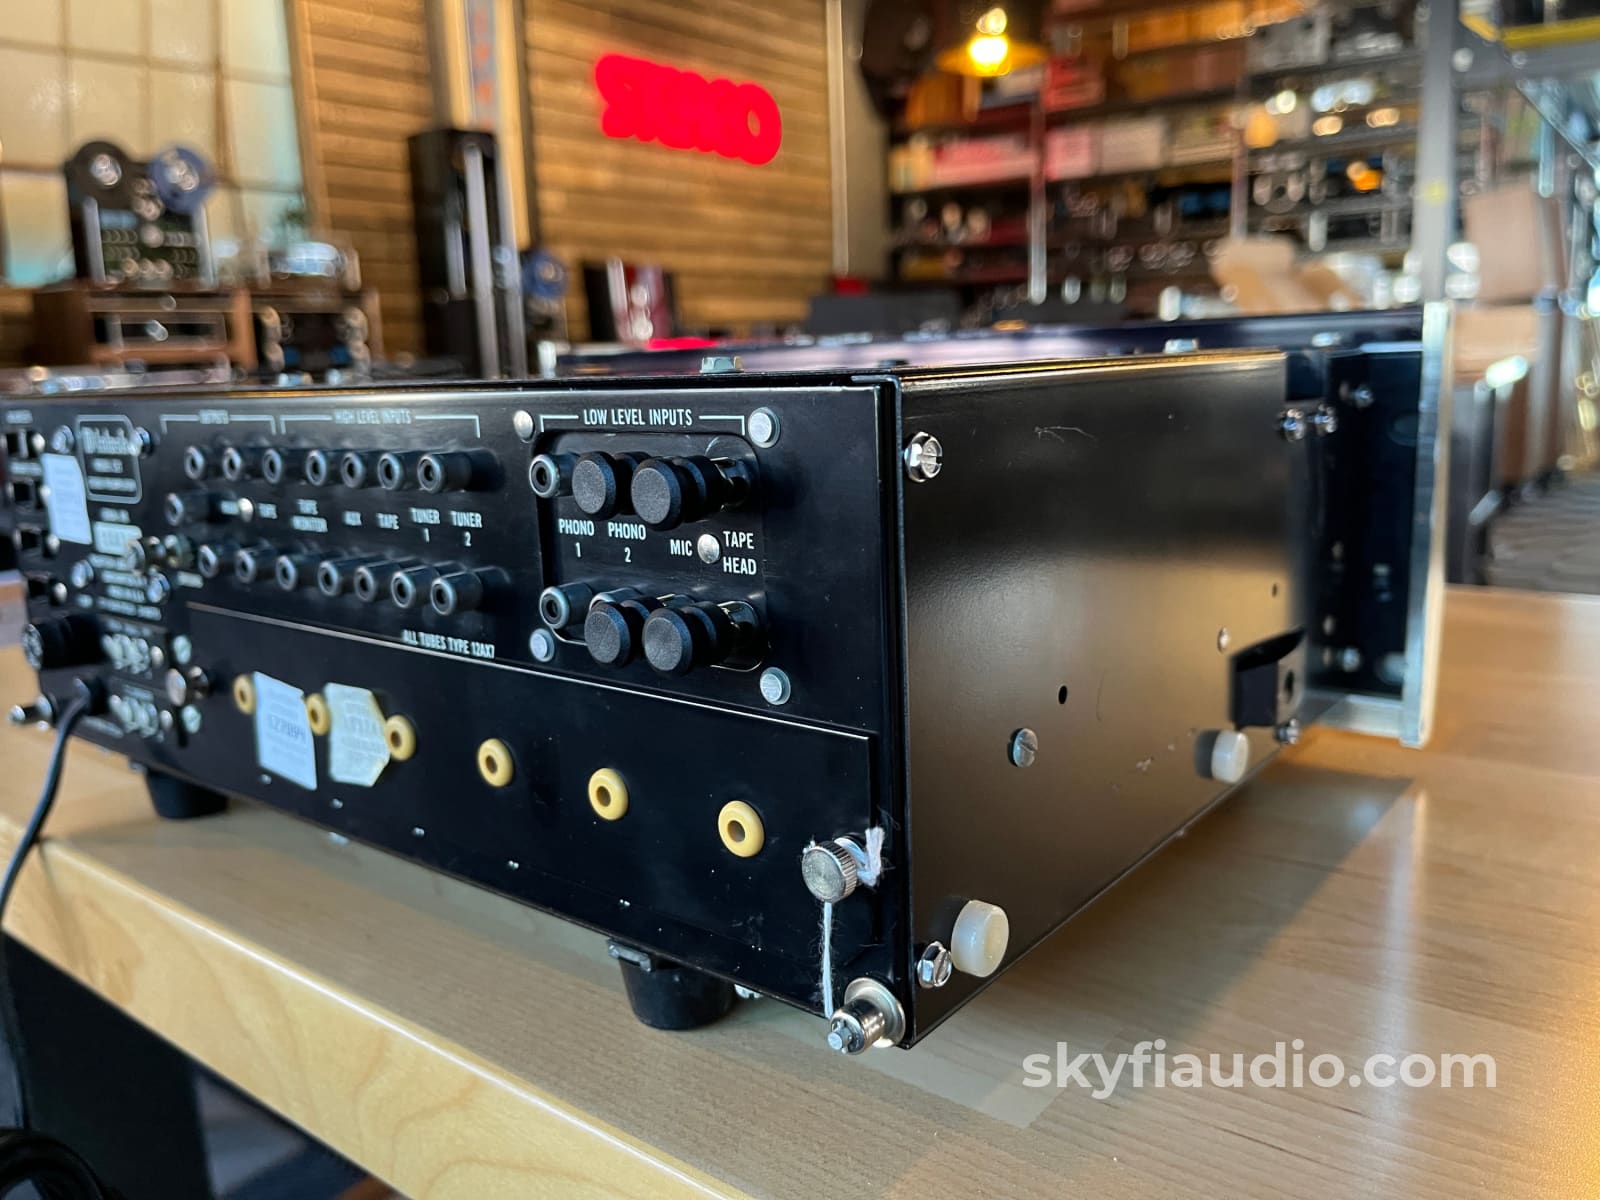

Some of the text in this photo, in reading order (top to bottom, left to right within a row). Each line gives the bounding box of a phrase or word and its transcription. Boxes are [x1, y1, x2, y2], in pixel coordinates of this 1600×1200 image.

[356, 408, 380, 425] LEVEL
[381, 408, 412, 425] INPUTS
[583, 408, 693, 426] LOW LEVEL INPUTS
[376, 513, 400, 530] TAPE
[409, 507, 441, 524] TUNER
[450, 510, 483, 528] TUNER
[422, 528, 430, 543] 1
[558, 518, 595, 536] PHONO
[608, 522, 647, 540] PHONO
[464, 531, 472, 547] 2
[670, 539, 693, 557] MIC
[723, 531, 755, 549] TAPE
[575, 542, 582, 558] 1
[624, 547, 631, 563] 2
[723, 557, 757, 575] HEAD
[402, 629, 495, 659] ALL TUBES TYPE 12AX7
